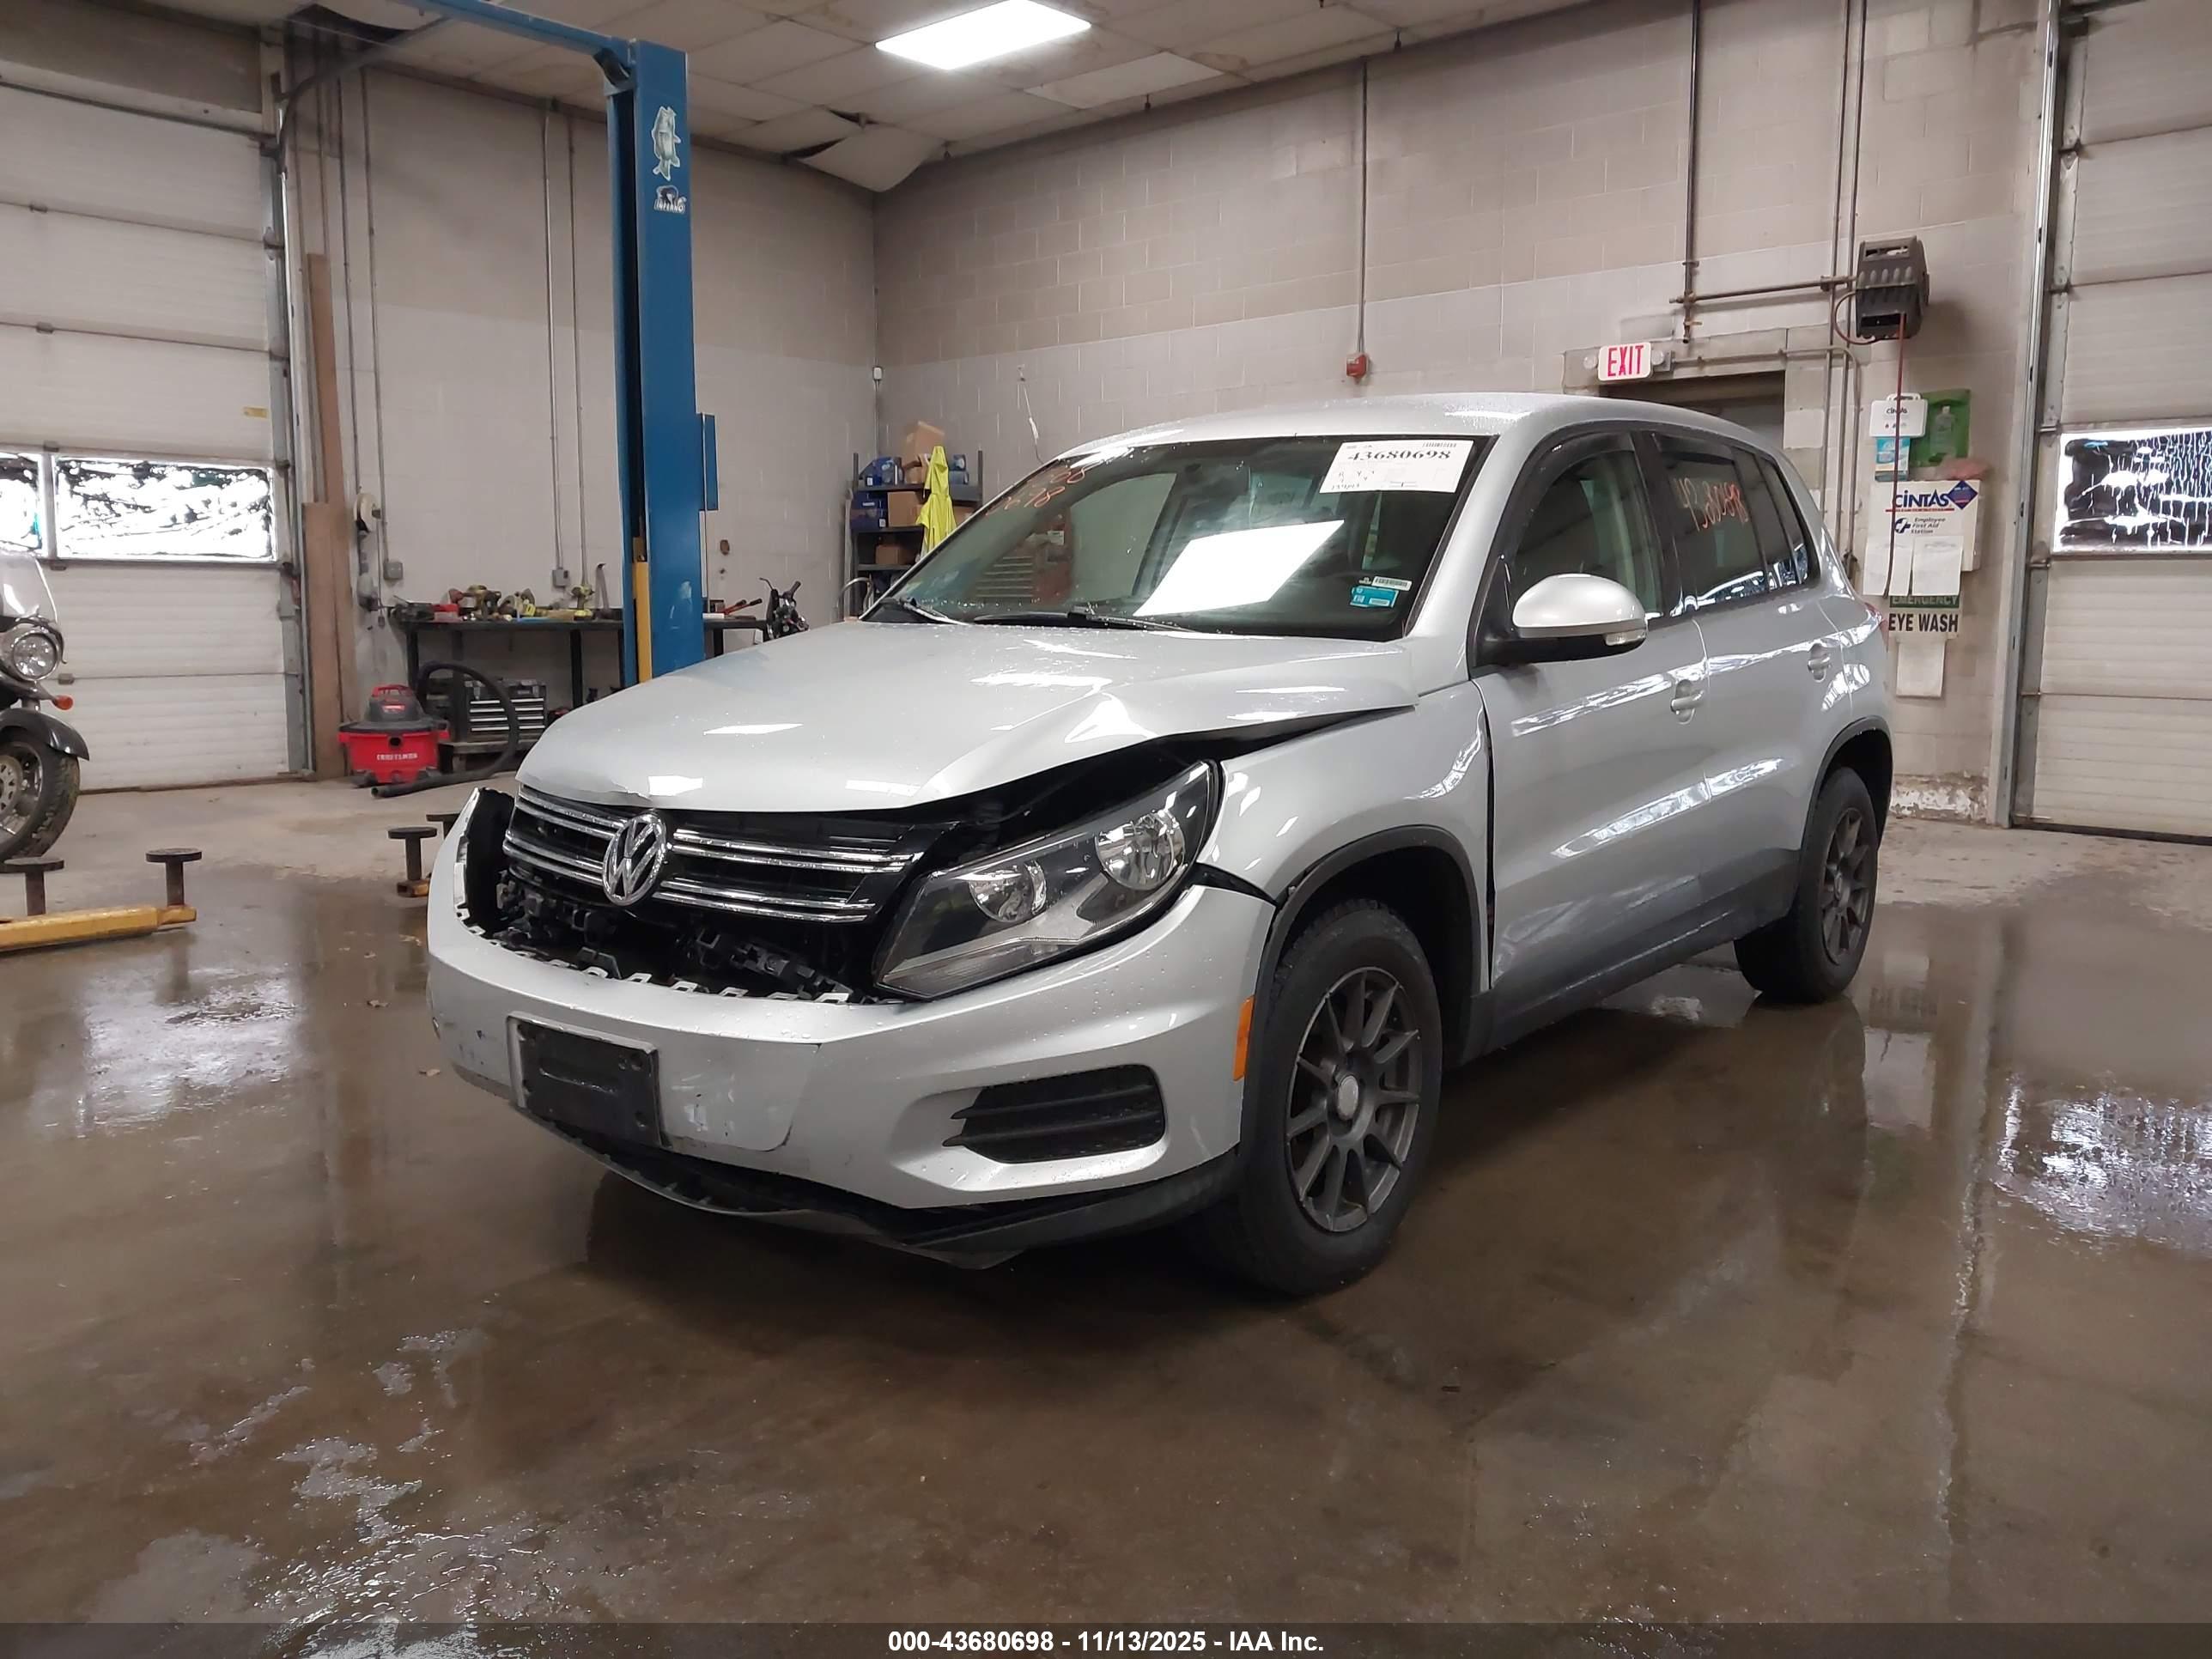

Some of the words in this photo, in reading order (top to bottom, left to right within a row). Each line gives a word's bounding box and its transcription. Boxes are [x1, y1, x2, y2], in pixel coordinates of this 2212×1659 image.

[1607, 345, 1644, 377] EXIT
[1347, 449, 1452, 461] 43680698
[1889, 613, 1913, 631] EYE
[1918, 613, 1959, 632] WASH
